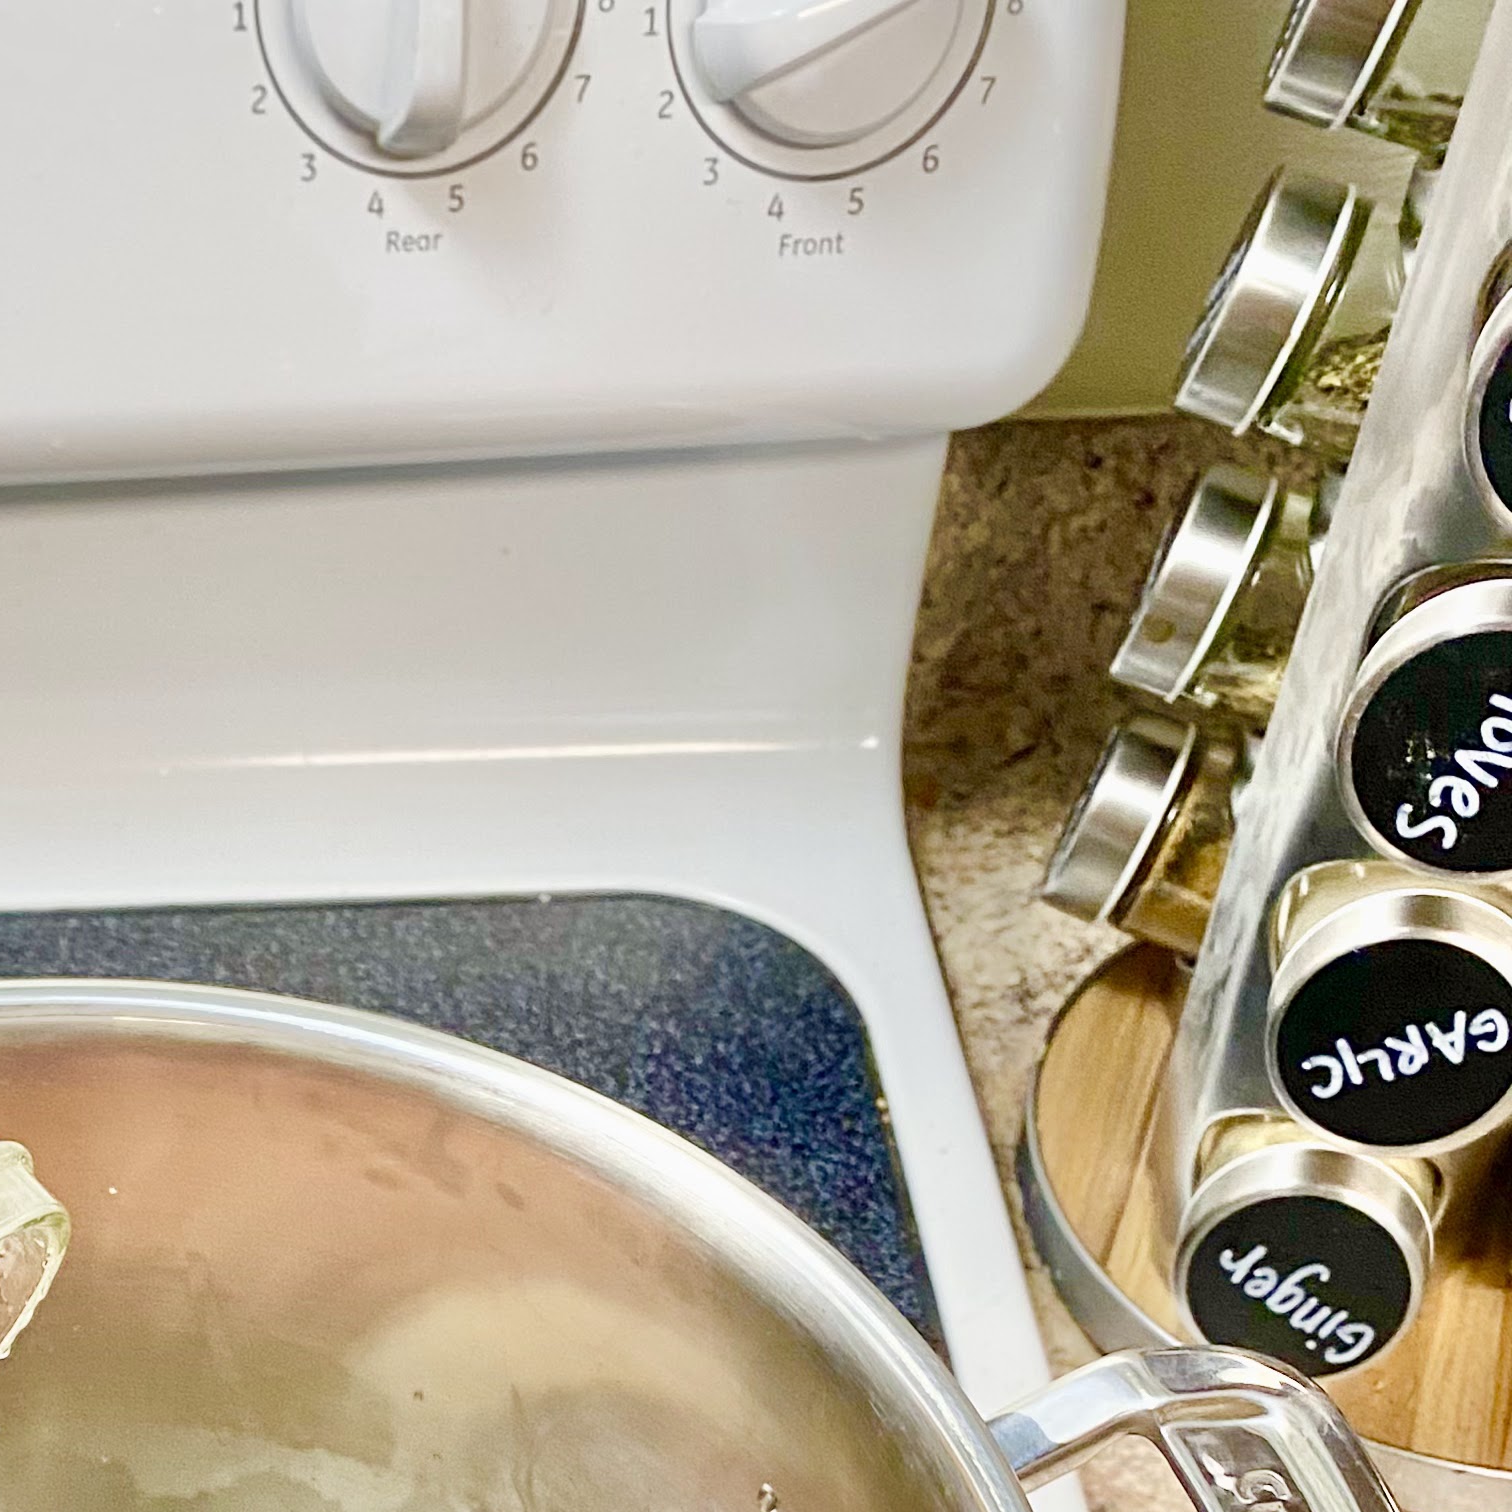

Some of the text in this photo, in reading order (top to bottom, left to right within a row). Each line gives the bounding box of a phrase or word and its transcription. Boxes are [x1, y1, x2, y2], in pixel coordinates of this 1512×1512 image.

[233, 2, 248, 31] 1
[644, 7, 659, 36] 1
[251, 85, 268, 115] 2
[575, 75, 592, 102] 7
[980, 77, 997, 104] 7
[657, 91, 675, 119] 2
[300, 154, 317, 182] 3
[521, 143, 538, 171] 6
[922, 145, 939, 173] 6
[702, 158, 719, 186] 3
[367, 191, 385, 219] 4
[448, 185, 464, 213] 5
[767, 194, 784, 221] 4
[847, 188, 864, 216] 5
[386, 231, 443, 253] Rear
[778, 232, 845, 256] Front
[1301, 1008, 1509, 1099] GARLIC
[1219, 1244, 1375, 1364] Ginger
